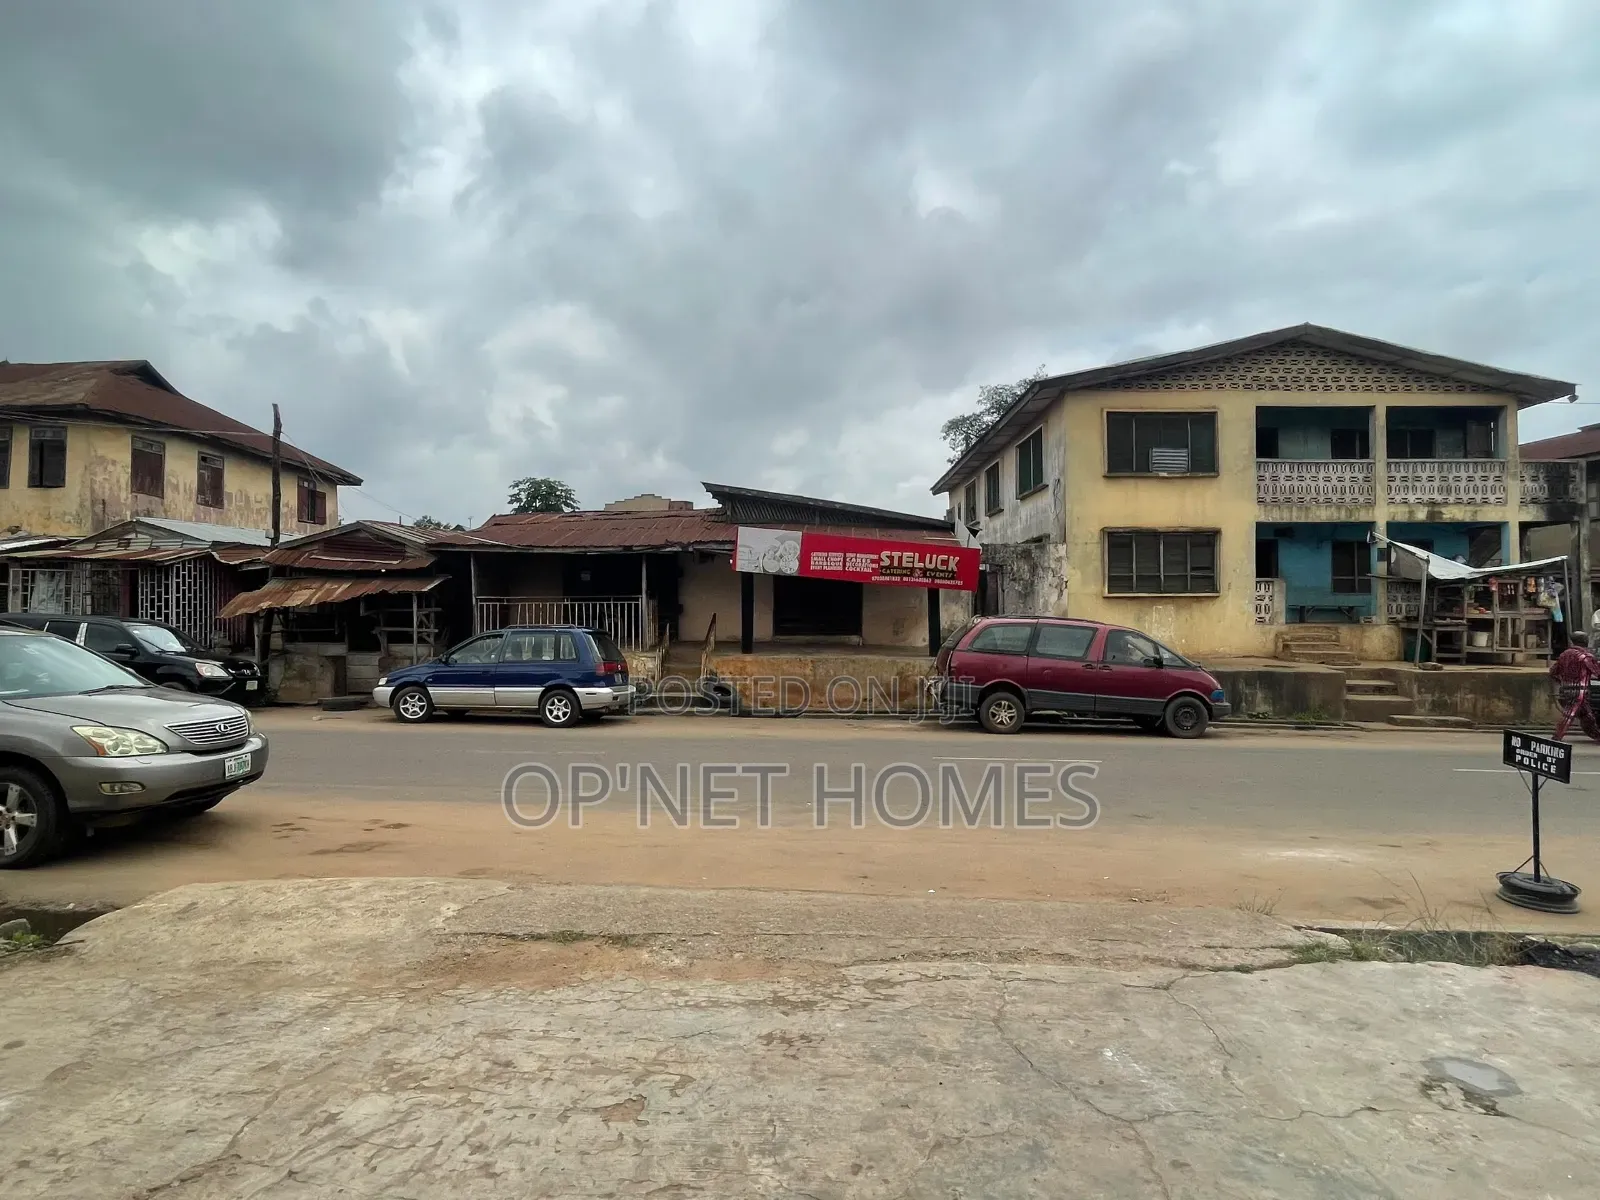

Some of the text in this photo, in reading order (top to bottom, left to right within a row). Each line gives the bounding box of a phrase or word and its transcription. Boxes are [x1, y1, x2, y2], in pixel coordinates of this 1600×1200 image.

[880, 551, 960, 572] STELUCK
[1511, 736, 1565, 759] NO PARKING
[1515, 748, 1538, 759] ORDER
[1515, 754, 1557, 774] POLICE
